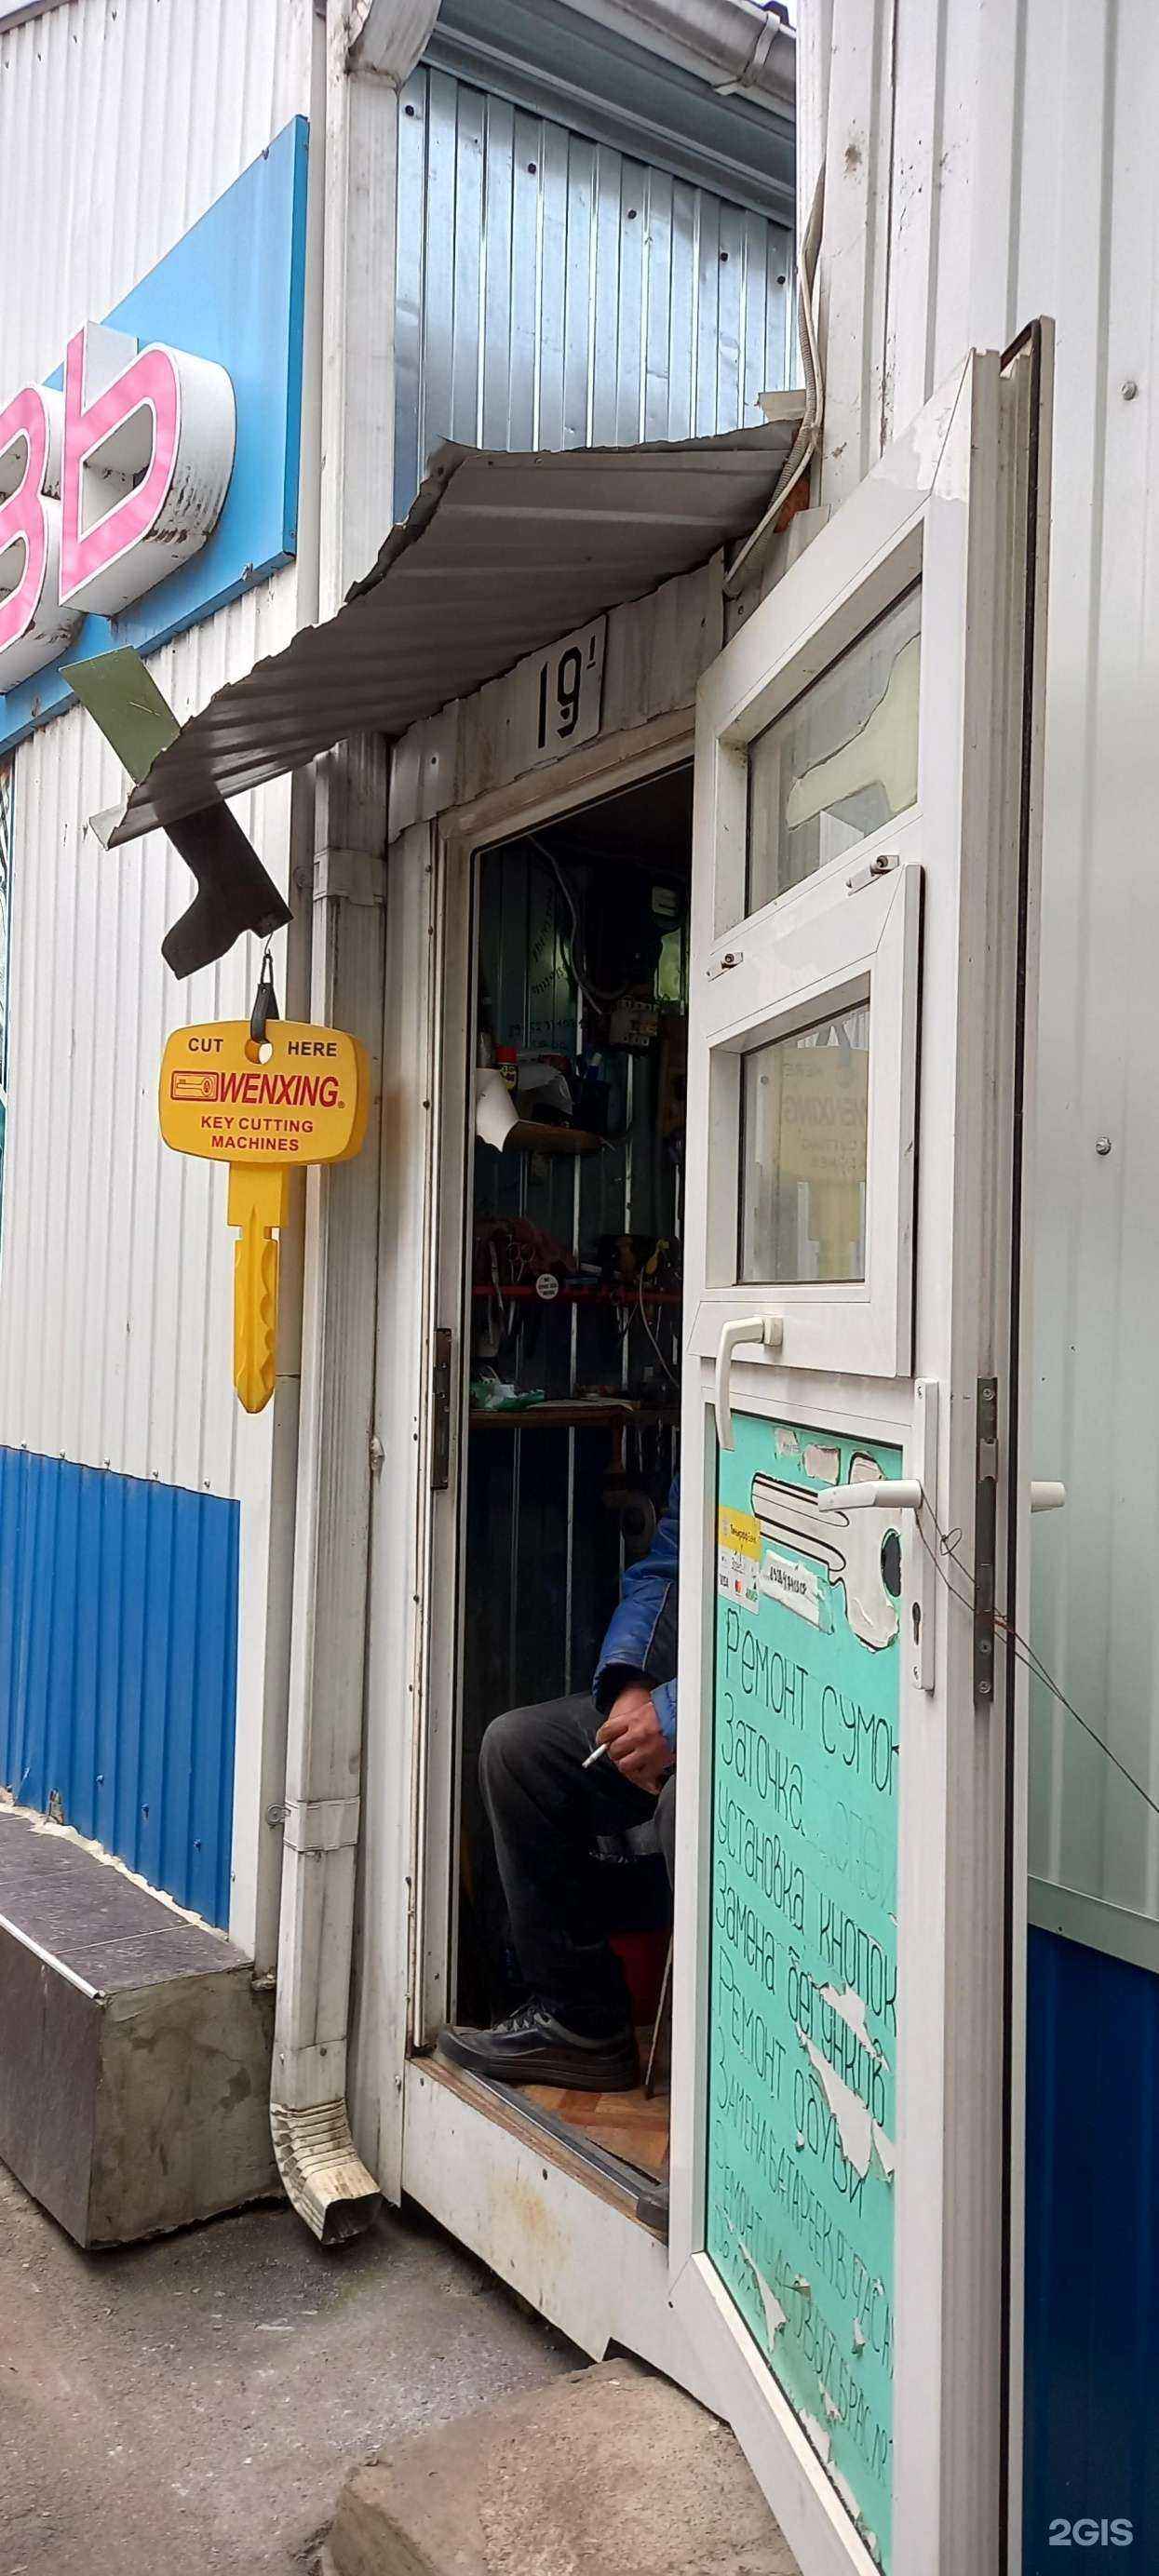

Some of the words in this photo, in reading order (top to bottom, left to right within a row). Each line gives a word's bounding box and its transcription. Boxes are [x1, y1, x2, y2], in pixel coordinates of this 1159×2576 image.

[188, 1038, 223, 1053] CUT
[288, 1040, 337, 1057] HERE
[201, 1116, 235, 1130] KEY
[238, 1118, 314, 1134] CUTTING
[211, 1135, 299, 1152] MACHINES
